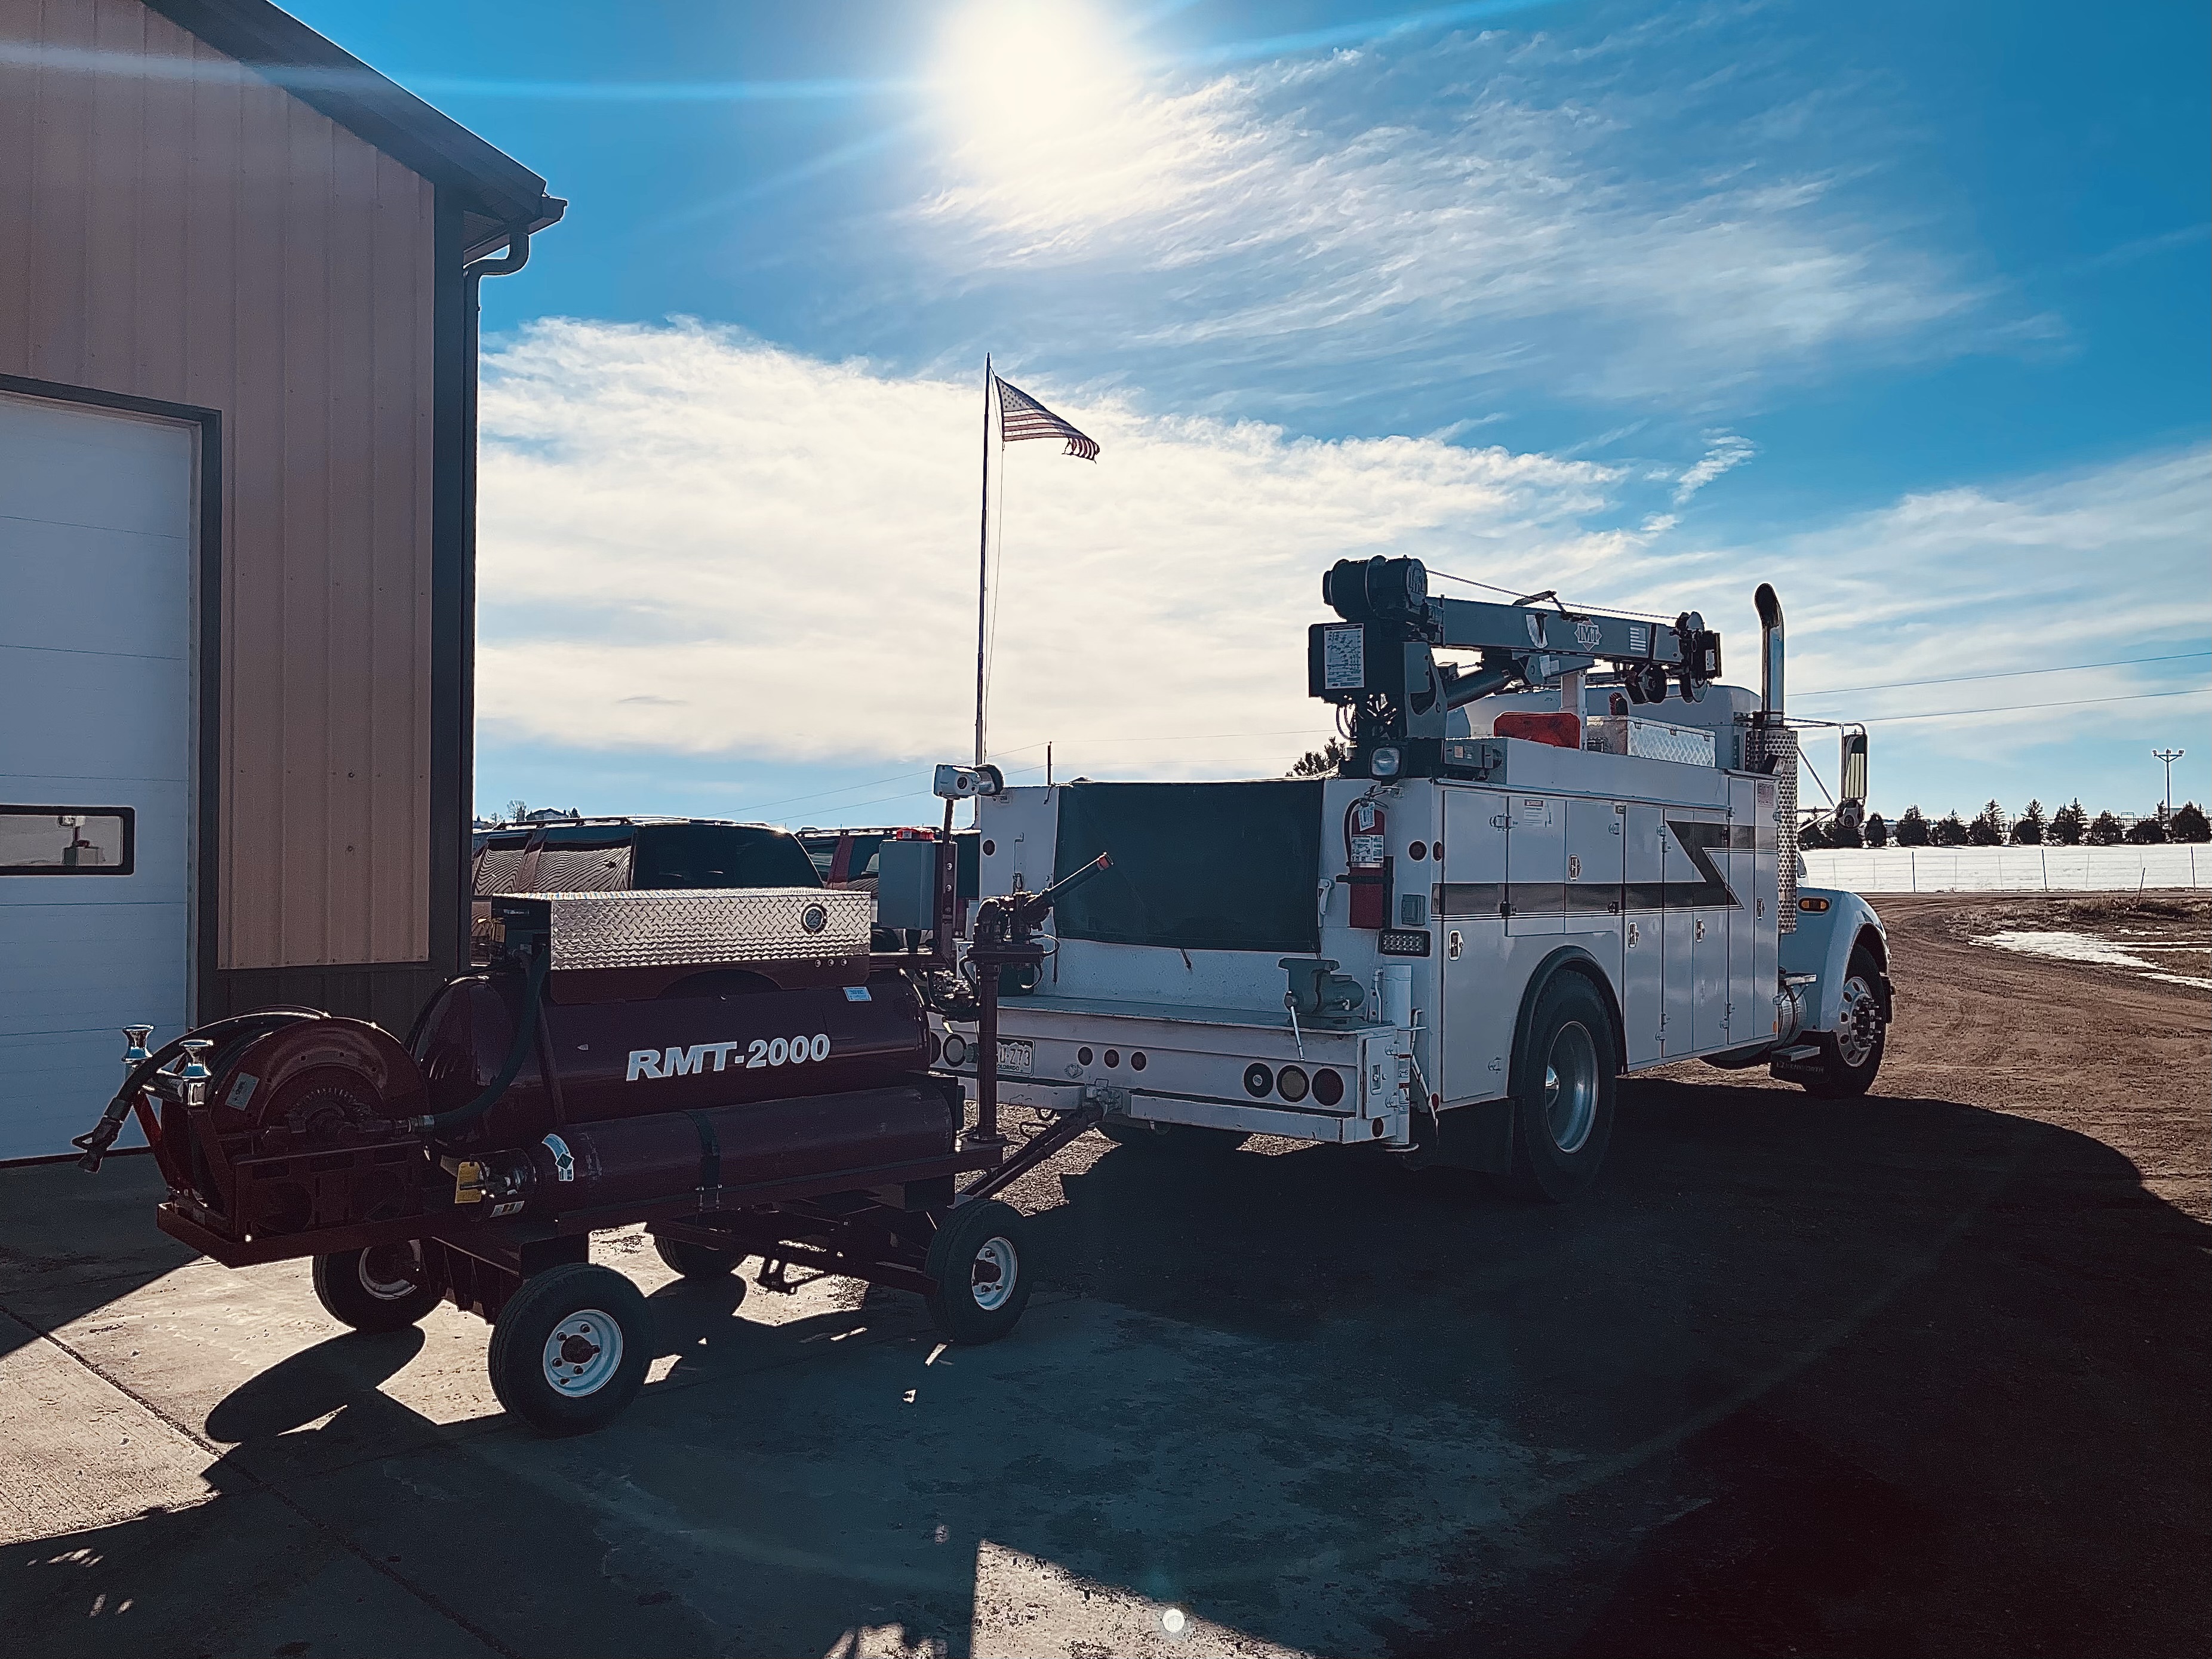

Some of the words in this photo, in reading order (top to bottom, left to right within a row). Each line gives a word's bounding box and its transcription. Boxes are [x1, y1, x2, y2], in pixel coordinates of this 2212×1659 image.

[1578, 625, 1598, 643] IMT
[626, 1033, 830, 1081] RMT-2000
[996, 1047, 1030, 1067] U-Z73
